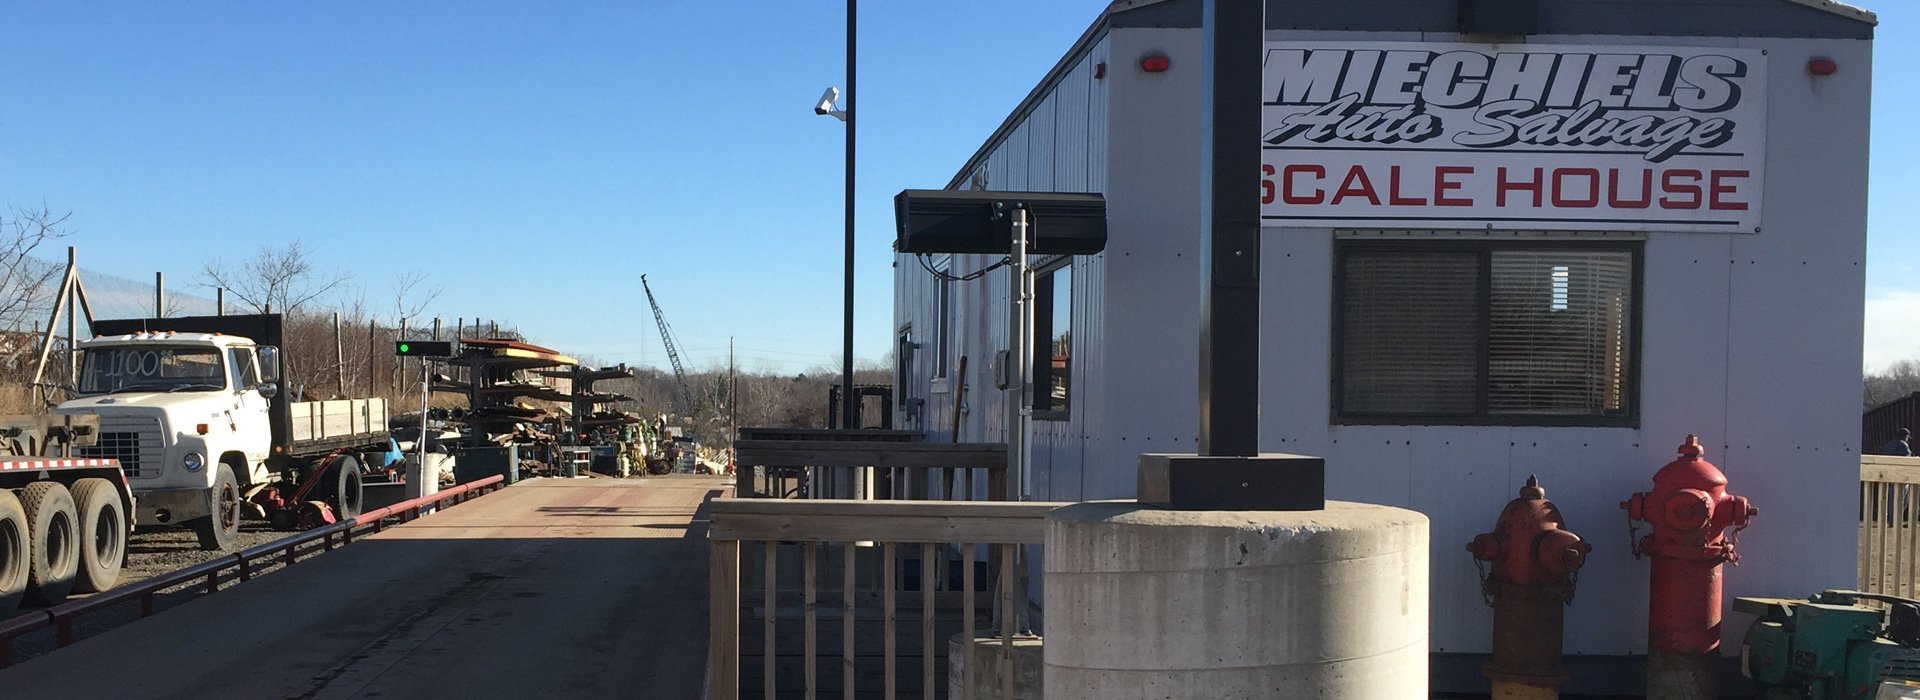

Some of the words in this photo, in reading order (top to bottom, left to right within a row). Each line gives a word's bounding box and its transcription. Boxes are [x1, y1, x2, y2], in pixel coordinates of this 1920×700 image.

[1262, 49, 1748, 112] MIECHIELS
[1262, 92, 1444, 145] Auto
[1452, 99, 1740, 163] Salvage
[1495, 167, 1750, 210] HOUSE
